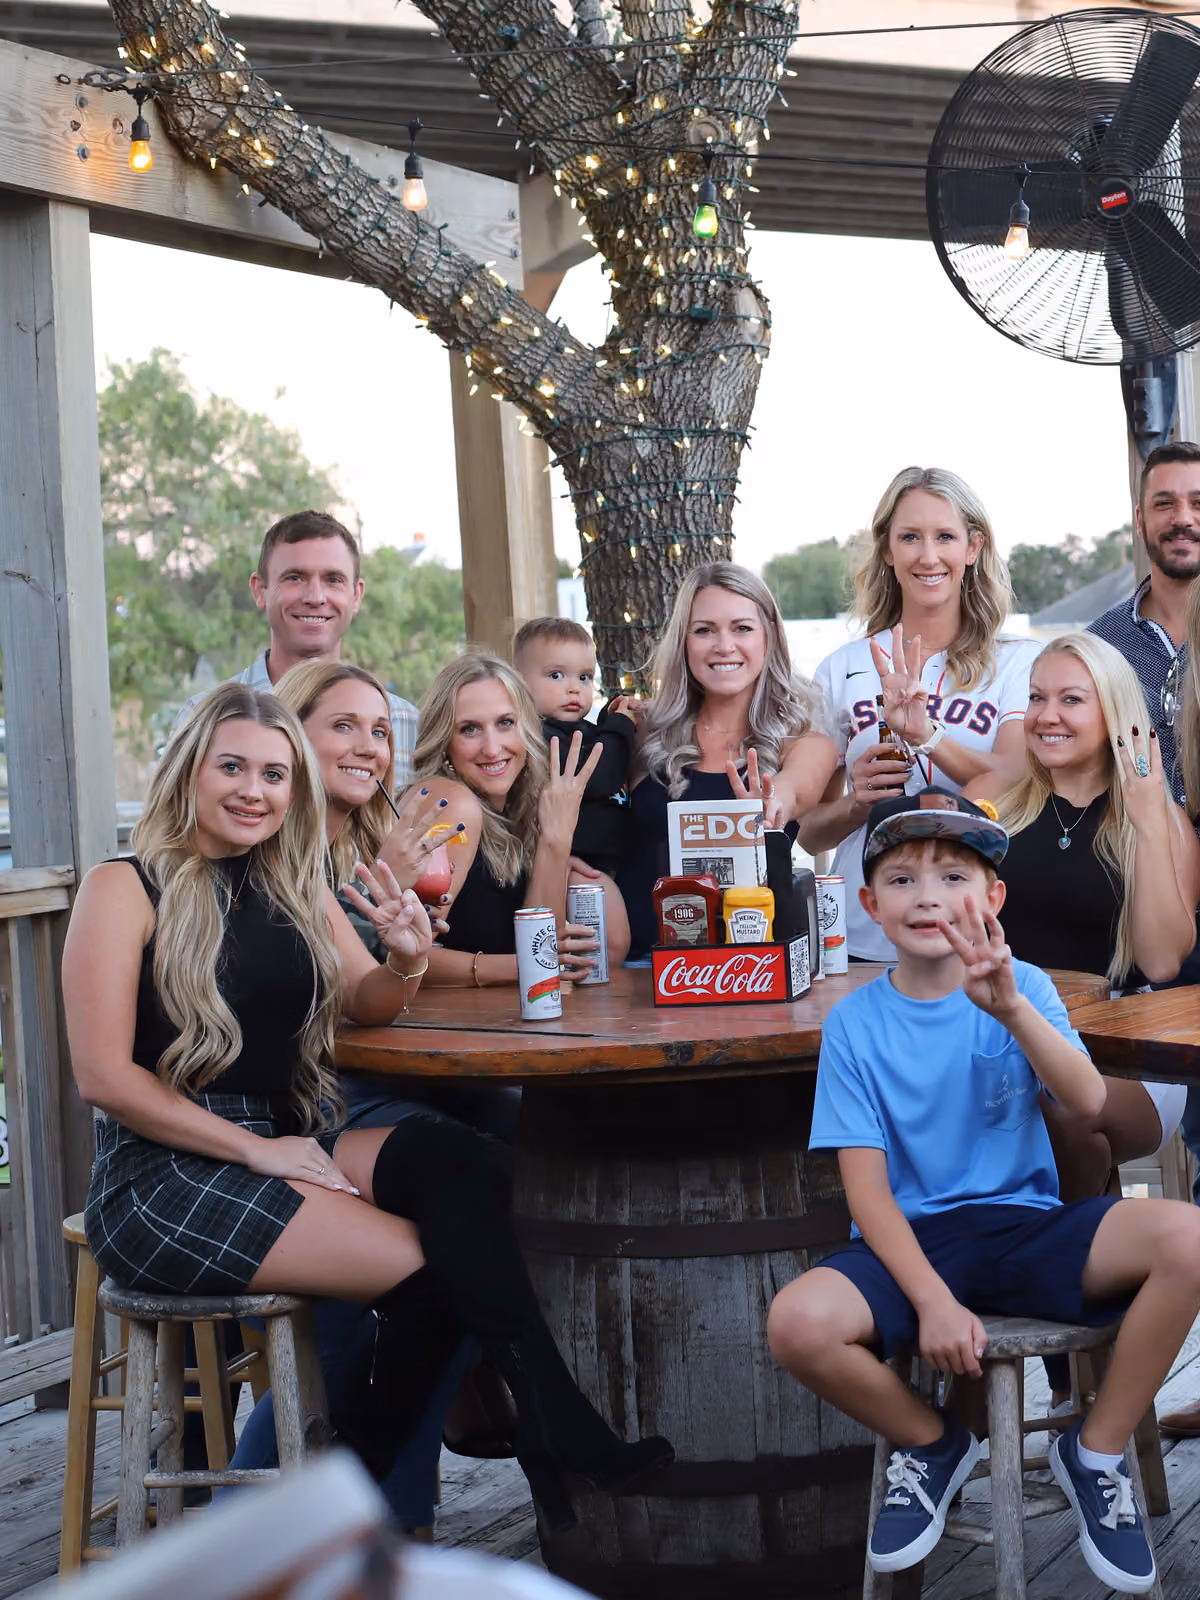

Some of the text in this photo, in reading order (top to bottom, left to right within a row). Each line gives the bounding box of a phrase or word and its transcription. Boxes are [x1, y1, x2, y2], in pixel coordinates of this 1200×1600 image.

[1101, 191, 1127, 203] Dayton
[682, 815, 704, 823] THE
[673, 908, 694, 919] 1906
[531, 928, 546, 956] WHITE
[658, 953, 780, 996] Coca-Cola
